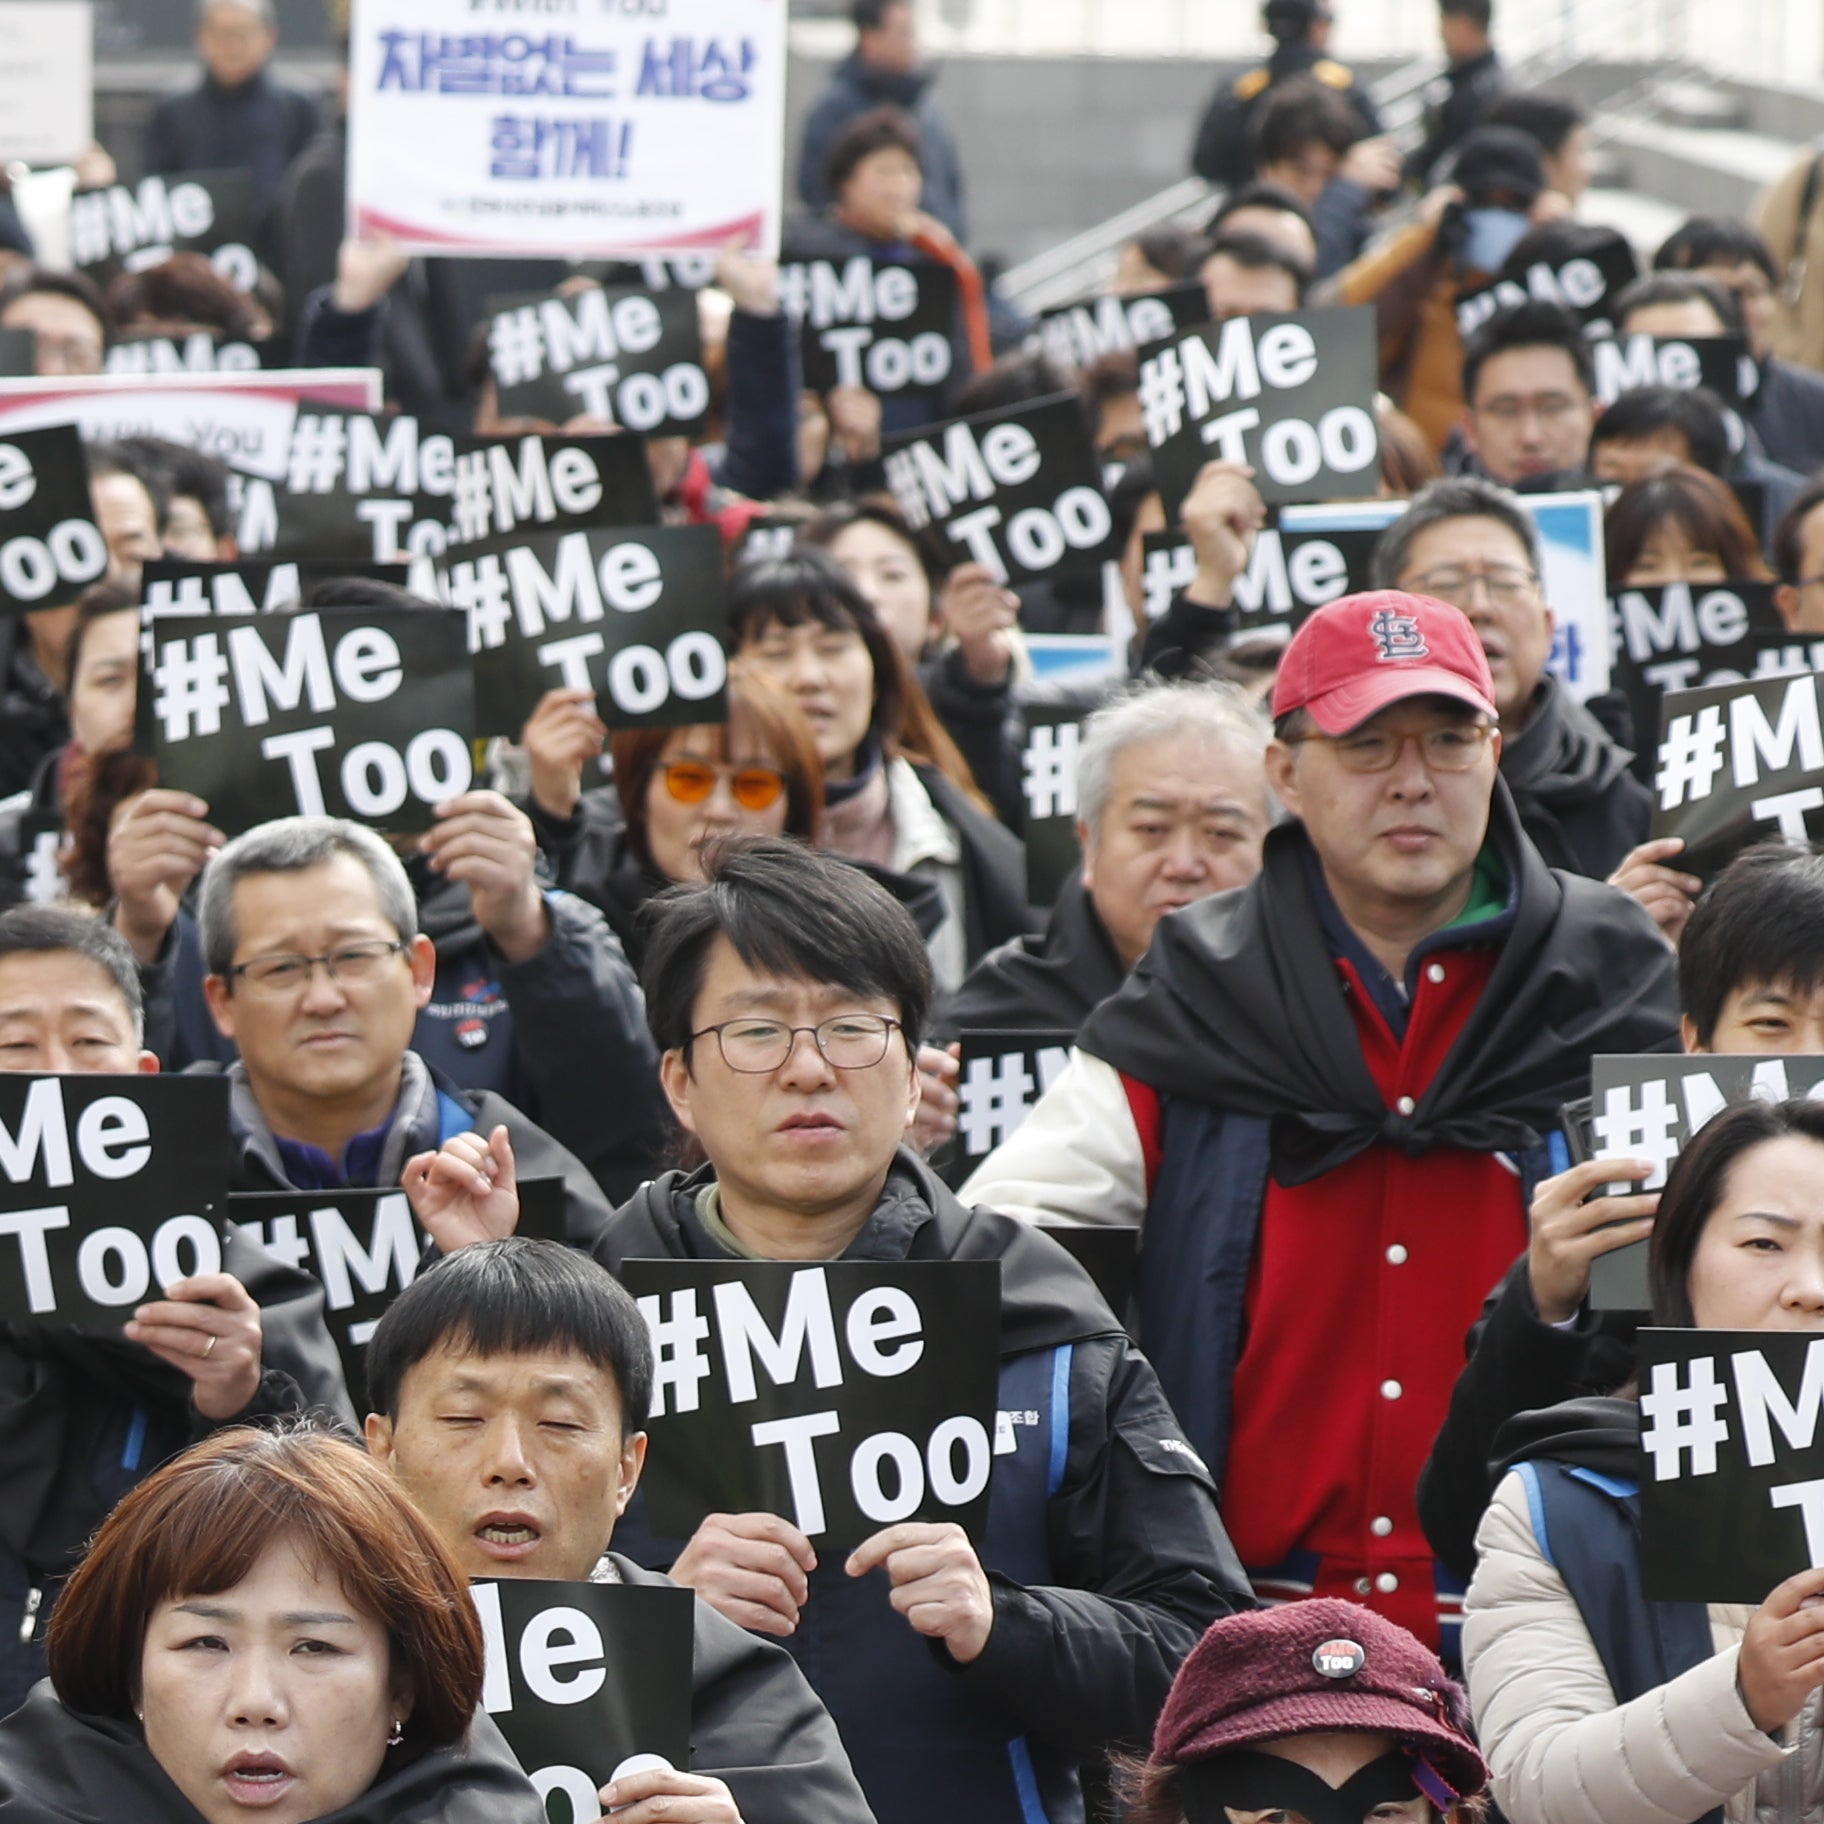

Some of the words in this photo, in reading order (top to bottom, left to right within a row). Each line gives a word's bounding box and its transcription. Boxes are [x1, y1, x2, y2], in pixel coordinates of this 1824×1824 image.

[377, 30, 616, 98] 차별없는
[635, 35, 756, 101] 세상
[490, 114, 635, 180] 함께!
[73, 178, 213, 264] #Me
[488, 292, 663, 387] #Me
[822, 328, 951, 391] Too
[1139, 319, 1319, 447] #Me
[1593, 334, 1702, 407] Me
[565, 362, 710, 431] Too
[287, 414, 455, 495] #Me
[451, 435, 604, 544] #Me
[886, 421, 1041, 532] #Me
[1203, 405, 1379, 486] Too
[948, 484, 1113, 585] Too
[450, 532, 663, 654] #Me
[155, 613, 405, 743] #Me
[538, 631, 728, 715] Too
[261, 725, 474, 821] Too
[1655, 676, 1824, 812] #M
[643, 1266, 926, 1419] #Me
[1640, 1338, 1824, 1482] #M
[753, 1406, 995, 1537] Too
